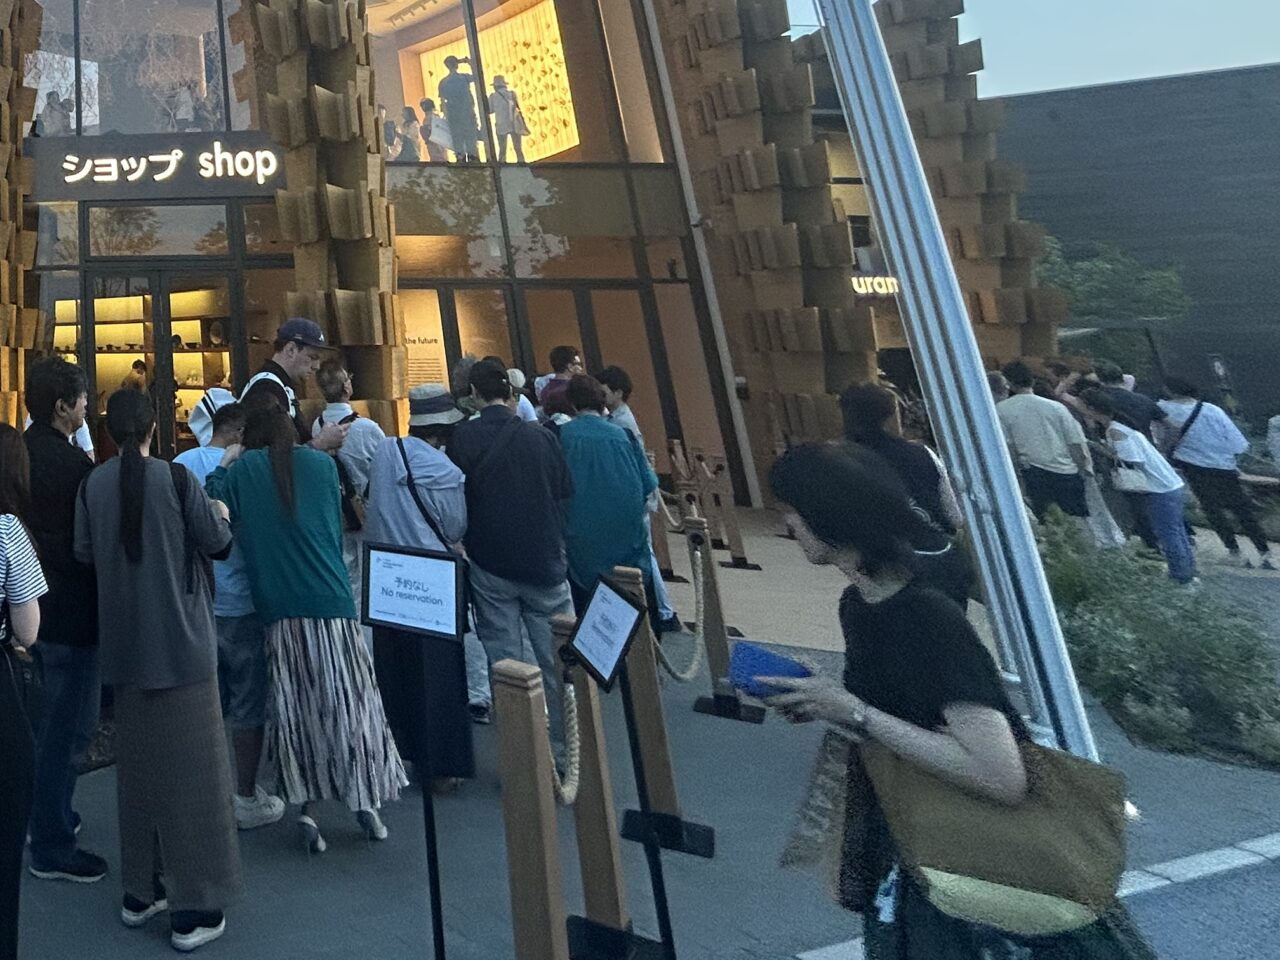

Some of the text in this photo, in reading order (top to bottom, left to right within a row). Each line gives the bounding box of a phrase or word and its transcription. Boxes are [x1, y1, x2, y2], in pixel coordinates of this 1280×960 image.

[62, 141, 278, 185] ショップ shop
[418, 336, 438, 344] future
[381, 587, 443, 606] No reservation
